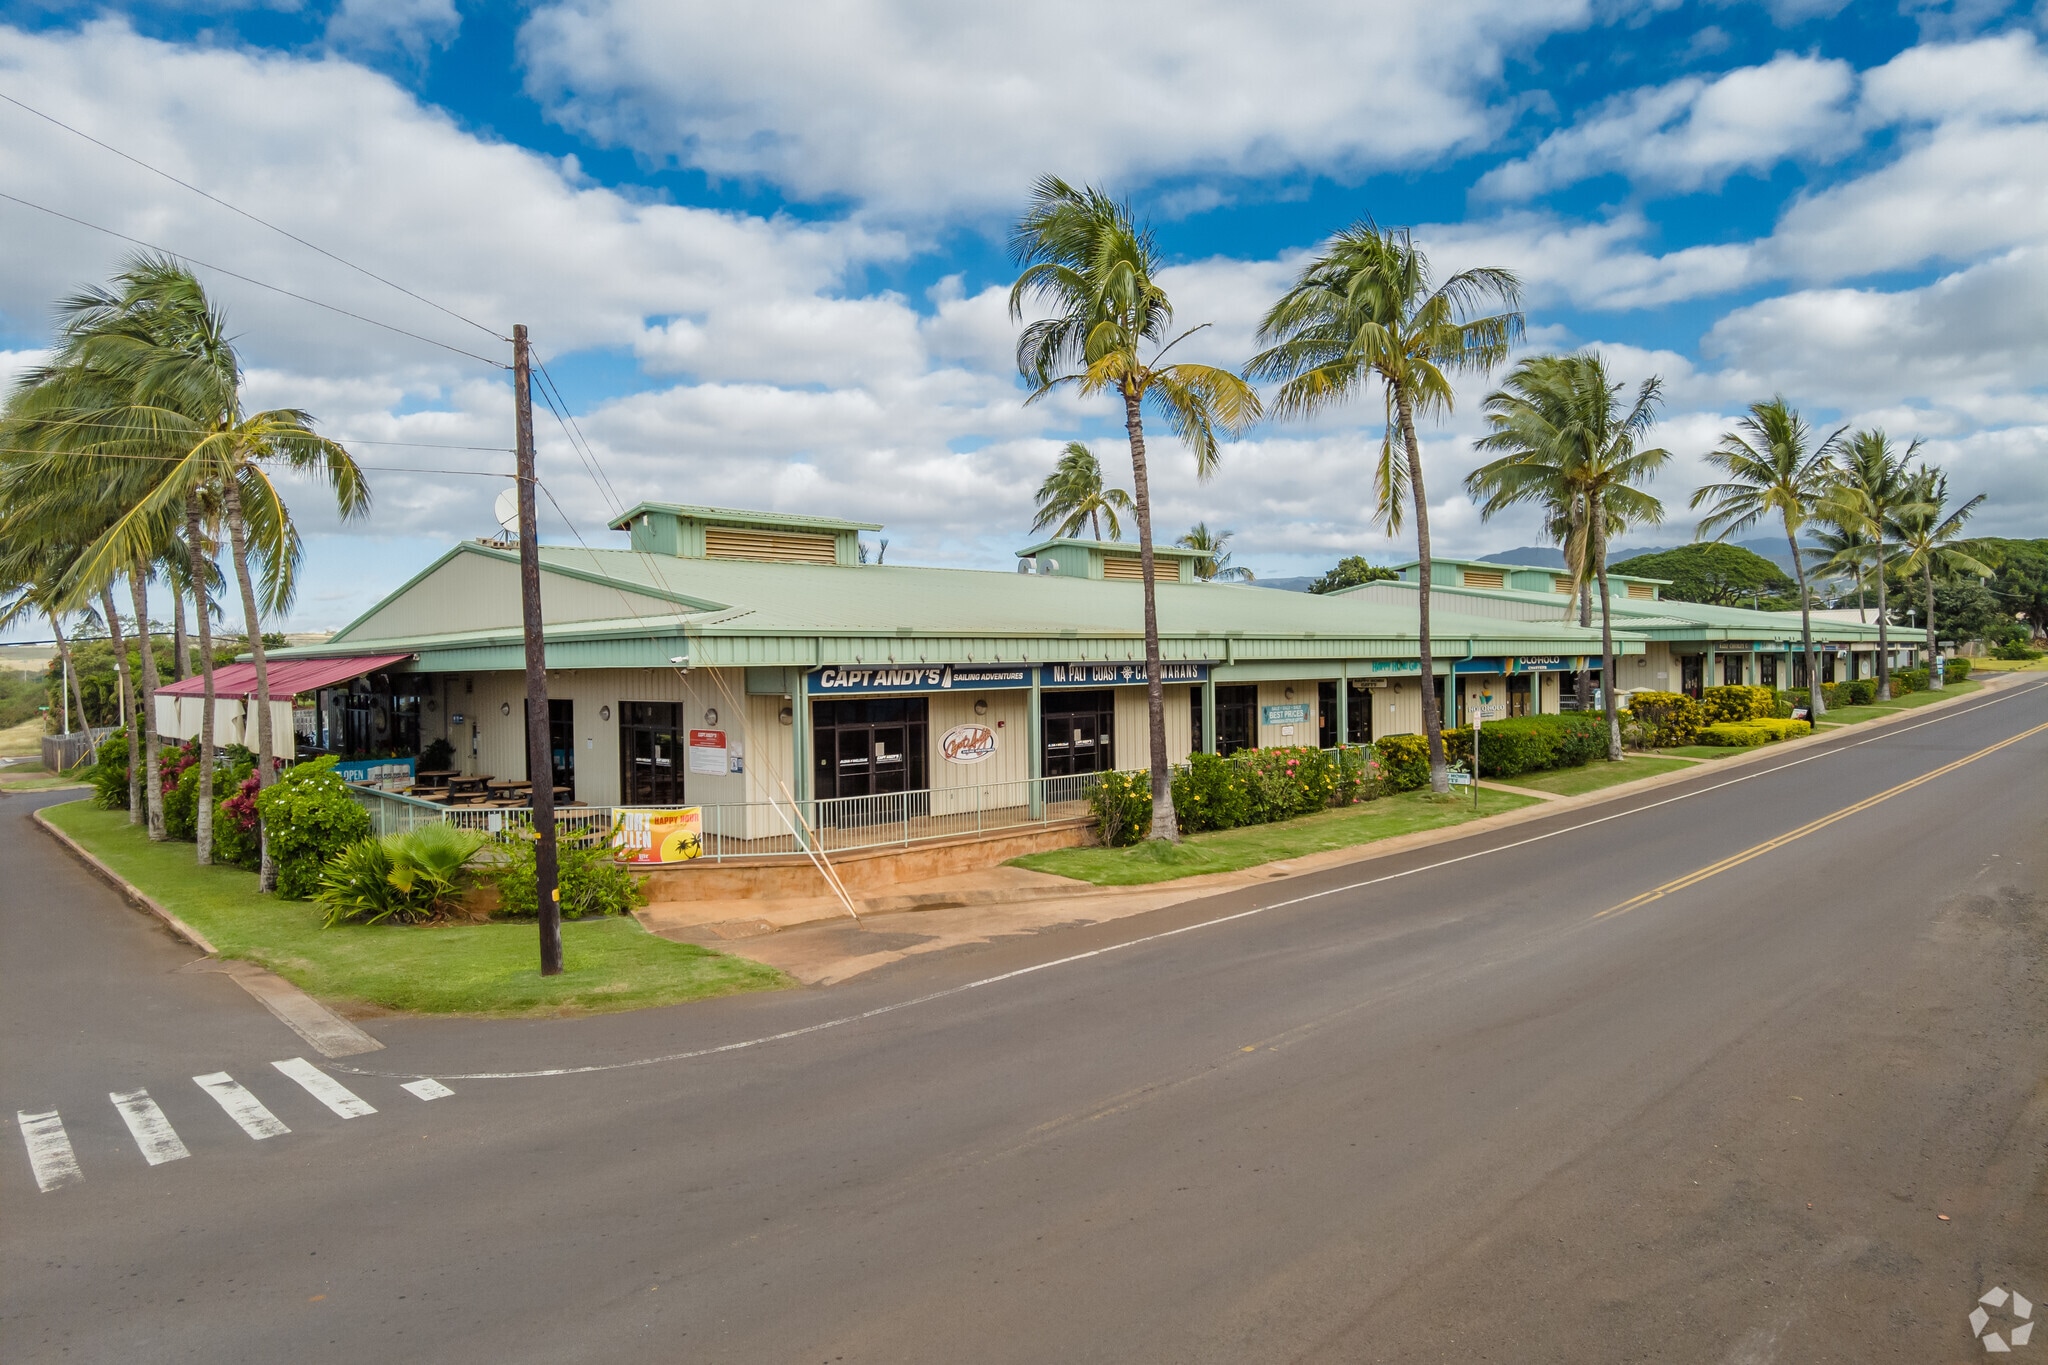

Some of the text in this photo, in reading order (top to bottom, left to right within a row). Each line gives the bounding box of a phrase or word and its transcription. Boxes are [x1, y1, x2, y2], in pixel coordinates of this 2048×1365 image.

[821, 669, 1024, 688] CAPT ANDY'S SAILING ADVENTURES
[1054, 665, 1066, 682] NA
[1069, 665, 1086, 682] PALI
[1135, 664, 1198, 680] CAMARANS
[1270, 710, 1304, 719] BEST PRICES
[343, 769, 364, 781] OPEN
[655, 813, 699, 825] HAPPY HOUR
[613, 830, 652, 849] ALLEN
